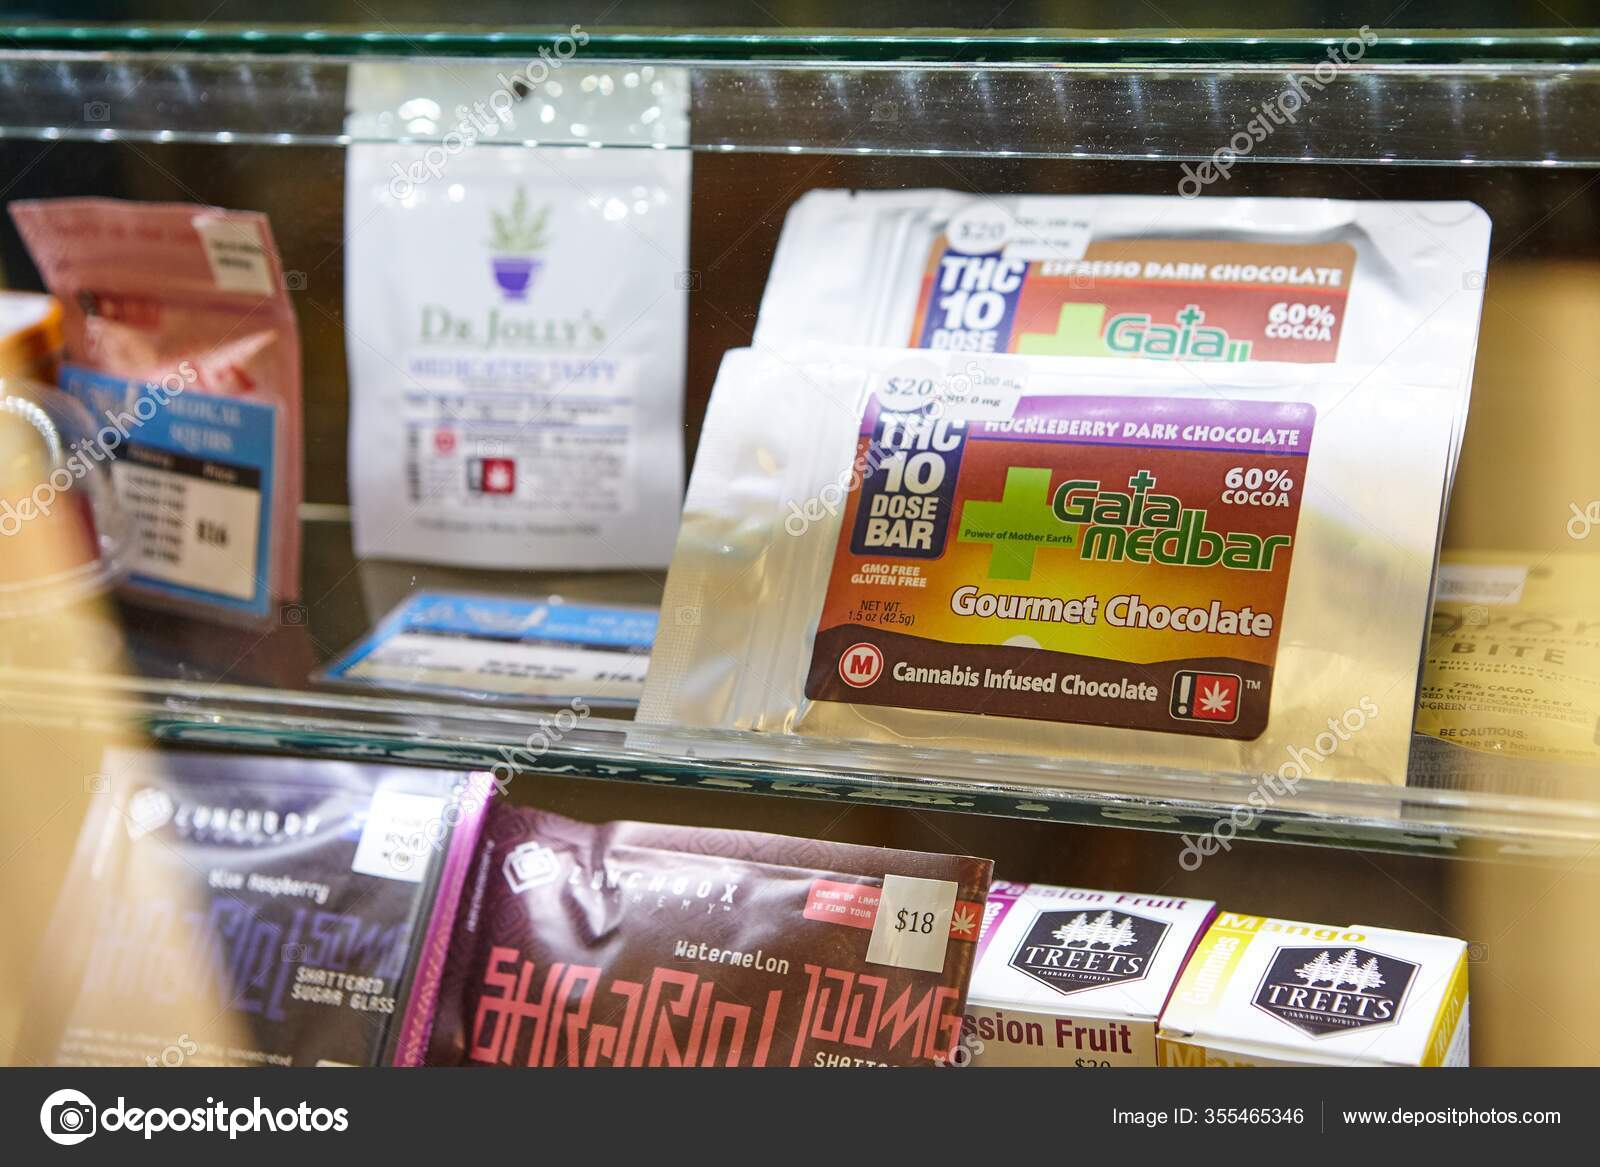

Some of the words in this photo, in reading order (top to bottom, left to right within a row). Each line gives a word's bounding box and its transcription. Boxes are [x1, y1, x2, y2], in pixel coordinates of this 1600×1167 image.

[940, 256, 1026, 293] THC
[1144, 262, 1207, 280] DARK
[1210, 264, 1342, 286] CHOCOLATE
[939, 290, 1006, 330] 10
[1268, 303, 1335, 327] 60%
[930, 329, 998, 352] DOSE
[1105, 305, 1228, 359] Gaia
[1265, 323, 1331, 342] COCOA
[884, 377, 933, 397] $20
[983, 398, 1001, 408] mg
[880, 412, 965, 451] THC
[984, 418, 1119, 438] HUCKLEBERRY
[1122, 422, 1177, 440] DARK
[1182, 424, 1300, 446] CHOCOLATE
[879, 451, 946, 494] 10
[1224, 467, 1293, 491] 60%
[870, 495, 939, 520] DOSE
[1052, 470, 1182, 530] Gaia
[1221, 490, 1290, 507] COCOA
[864, 518, 934, 550] BAR
[964, 528, 994, 540] Power
[998, 530, 1007, 539] of
[1009, 532, 1045, 542] Mother
[1046, 534, 1073, 544] Earth
[851, 573, 896, 586] GLUTEN
[898, 576, 927, 588] FREE
[861, 563, 890, 575] GMO
[891, 564, 920, 577] FREE
[861, 600, 881, 610] NET
[950, 585, 1098, 625] Gourmet
[1103, 595, 1273, 638] Chocolate
[848, 610, 862, 621] 1.5
[865, 613, 877, 622] oz
[879, 612, 915, 626] (42.5g)
[1451, 642, 1566, 665] BITE
[849, 655, 873, 676] M
[892, 661, 979, 688] Cannabis
[983, 667, 1056, 694] Infused
[1060, 675, 1158, 702] Chocolate
[1245, 679, 1260, 690] TM
[1488, 685, 1534, 694] CACAO
[1419, 701, 1466, 711] N-GREEN
[1446, 693, 1477, 702] WITH
[1449, 687, 1496, 697] trade
[1502, 694, 1573, 707] sourced
[1440, 728, 1456, 737] BE
[1460, 728, 1529, 740] CAUTIOUS:
[1509, 741, 1545, 752] hours
[569, 866, 737, 904] LUNCHBOX
[858, 895, 880, 906] LARG
[1110, 895, 1188, 911] Fruit
[850, 907, 871, 919] YOUR
[895, 908, 934, 934] $18
[1216, 913, 1367, 943] Mango
[674, 940, 790, 975] Watermelon
[1025, 946, 1143, 974] TREETS
[296, 966, 385, 994] SHATTERED
[1037, 969, 1075, 979] CANNABIS
[291, 984, 343, 1007] SUGAR
[350, 993, 395, 1014] GLASS
[1268, 984, 1394, 1020] TREETS
[961, 1012, 1043, 1047] ssion
[1056, 1018, 1132, 1053] Fruit
